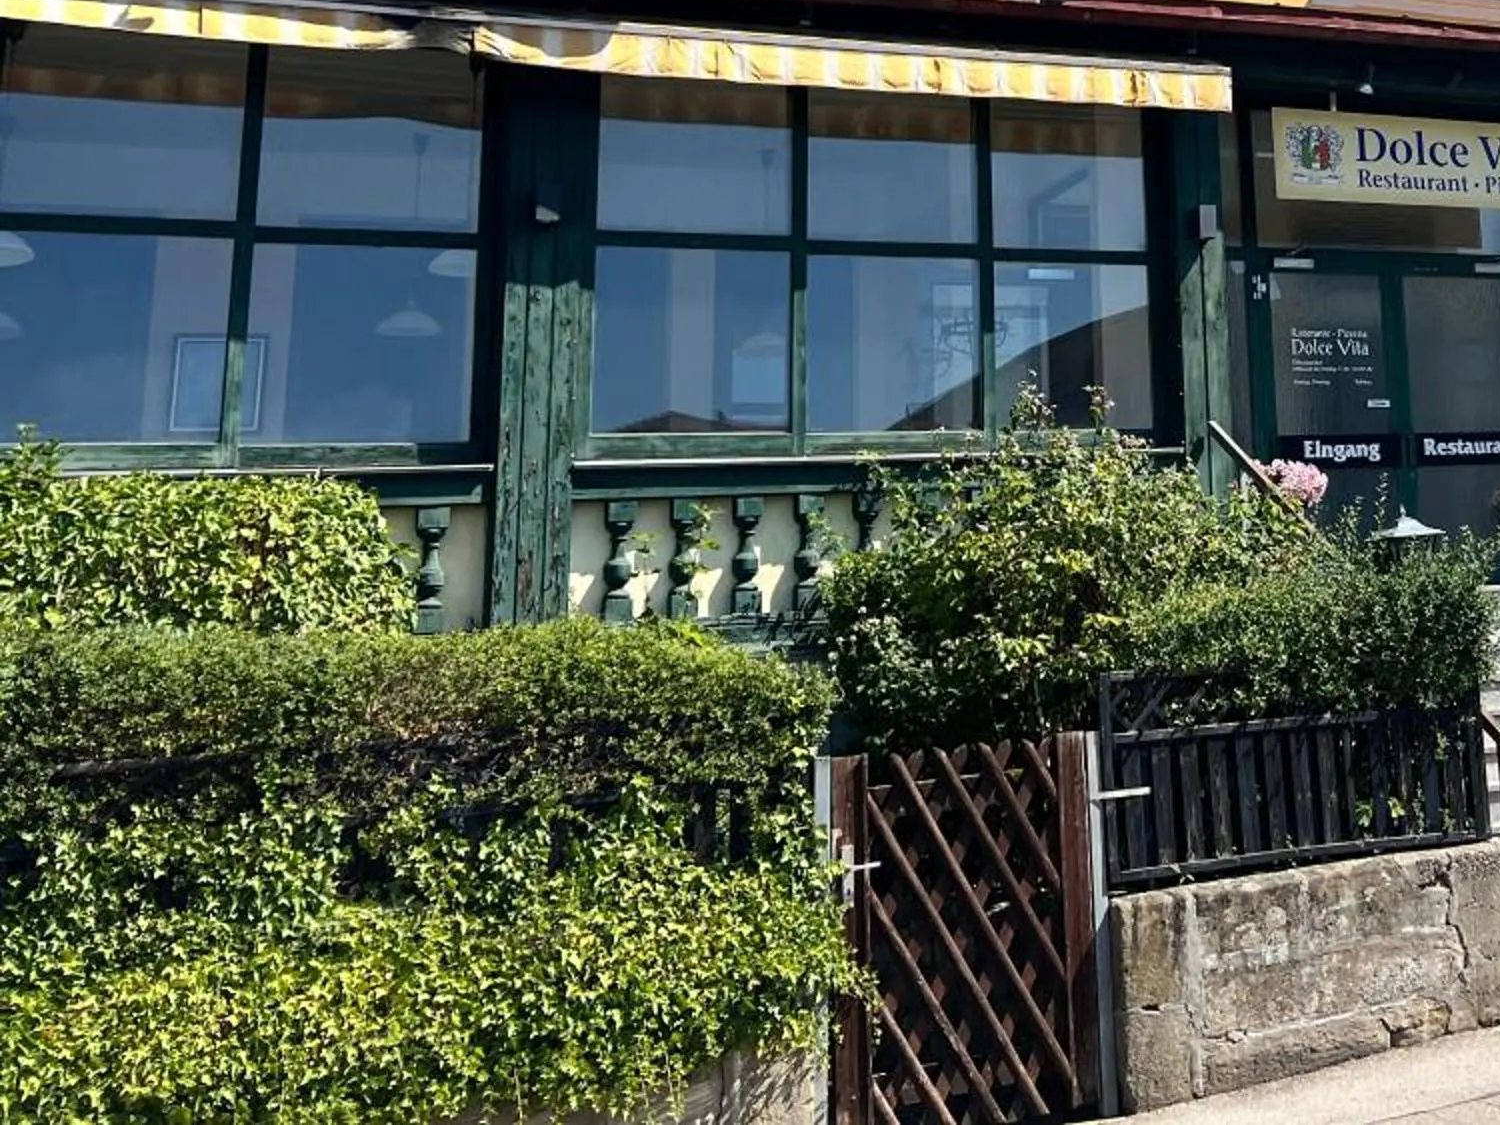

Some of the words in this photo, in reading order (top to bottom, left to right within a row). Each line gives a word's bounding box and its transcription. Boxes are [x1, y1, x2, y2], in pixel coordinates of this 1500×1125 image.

[1355, 126, 1469, 168] Dolce
[1358, 169, 1469, 193] Restaurant
[1291, 338, 1333, 355] Dolce
[1303, 440, 1381, 463] Eingang
